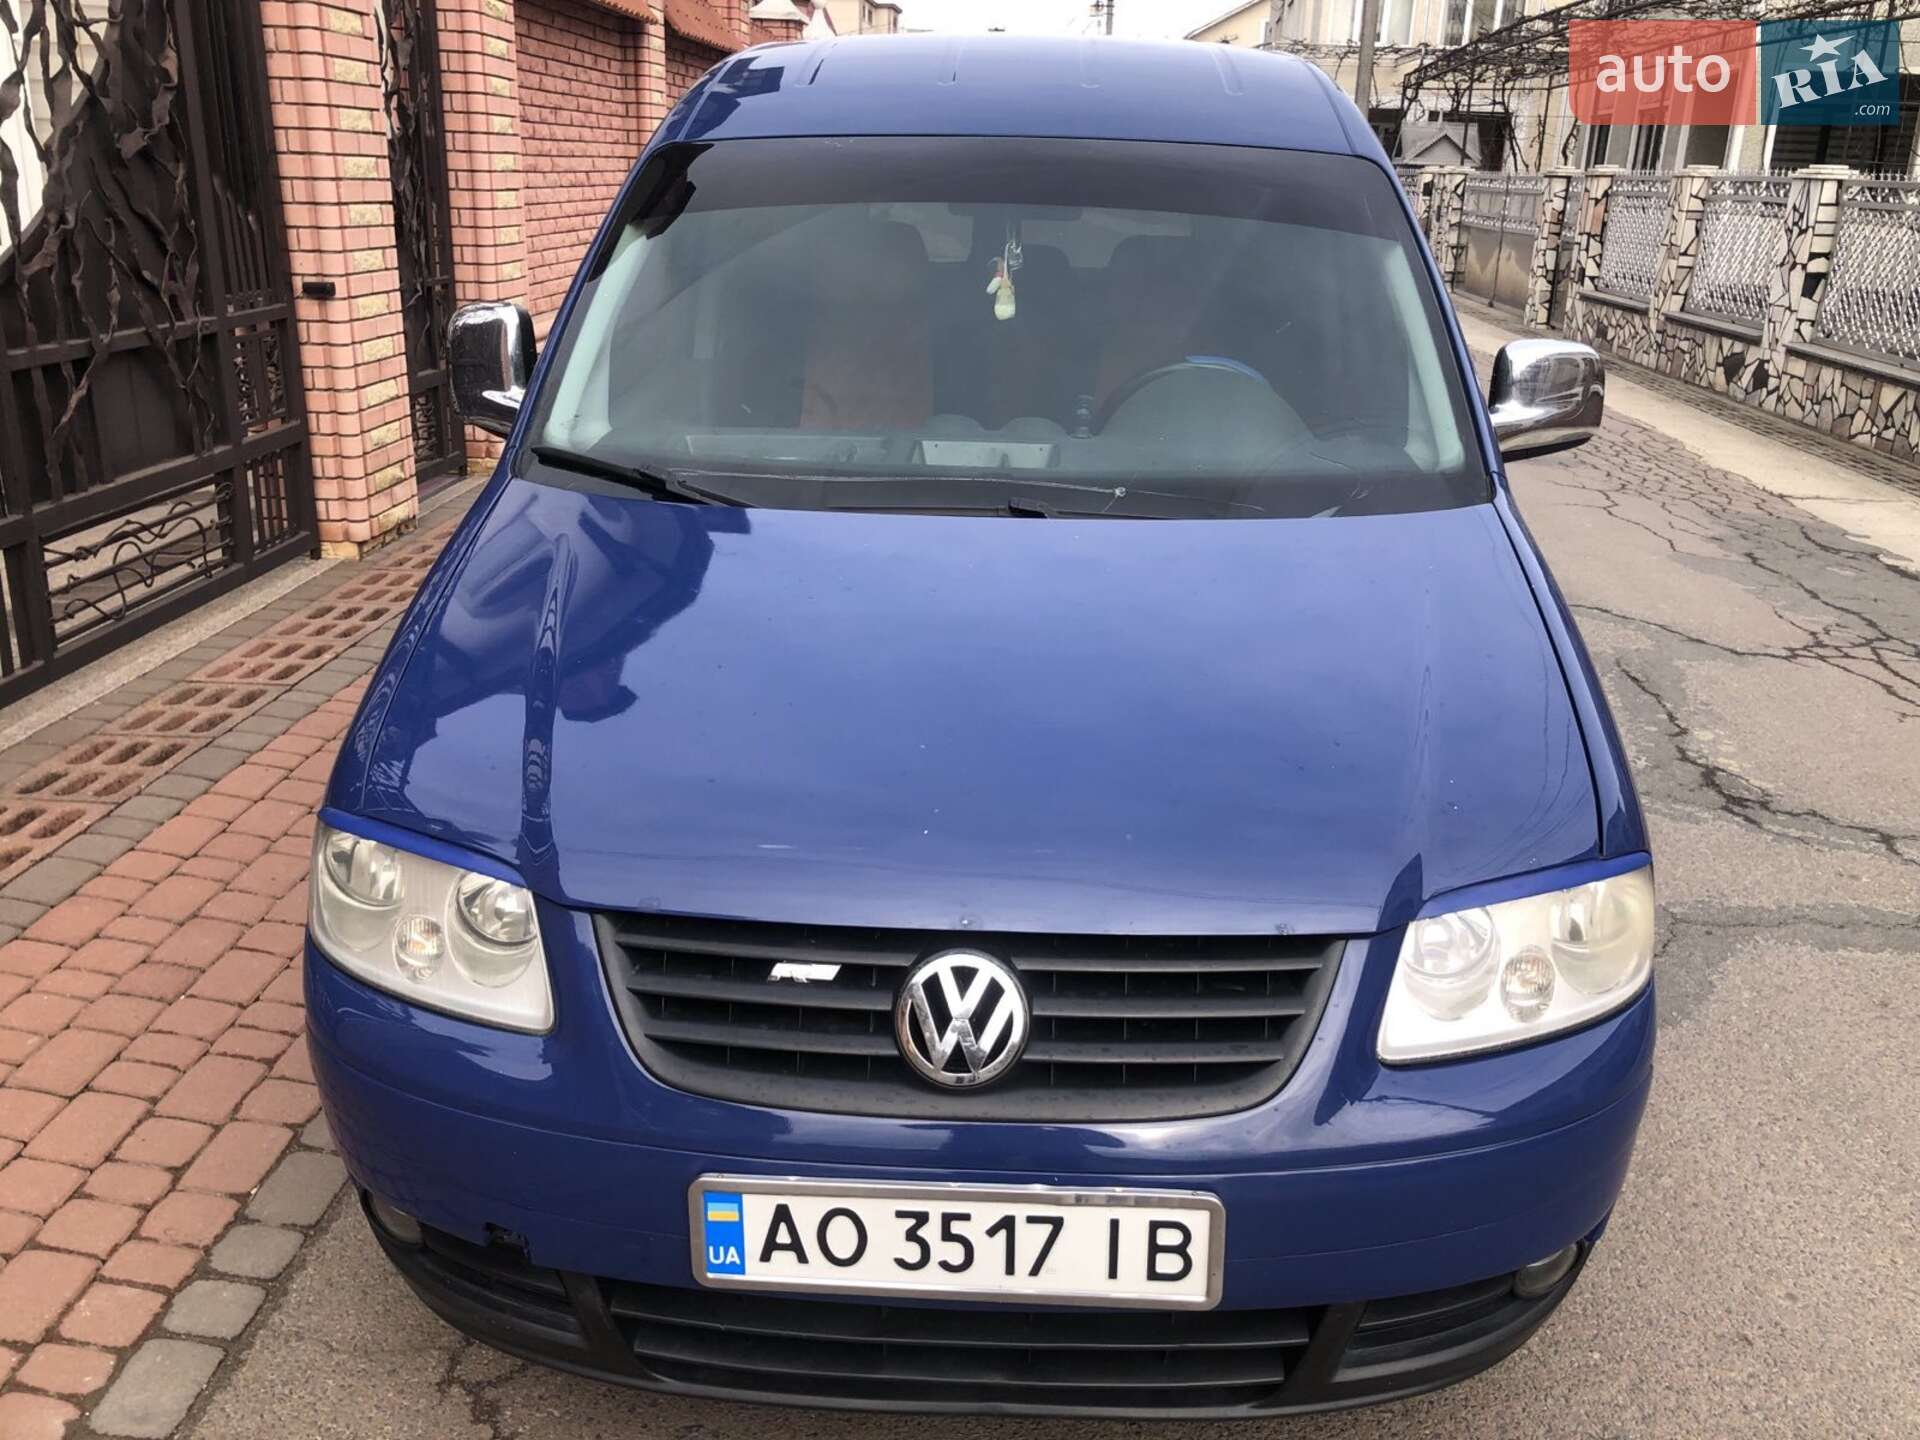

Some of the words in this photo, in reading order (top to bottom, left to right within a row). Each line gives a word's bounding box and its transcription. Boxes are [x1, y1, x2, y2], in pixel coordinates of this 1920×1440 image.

[708, 1246, 741, 1265] UA
[759, 1203, 868, 1267] AO
[893, 1210, 1064, 1277] 3517
[1107, 1218, 1193, 1281] IB
